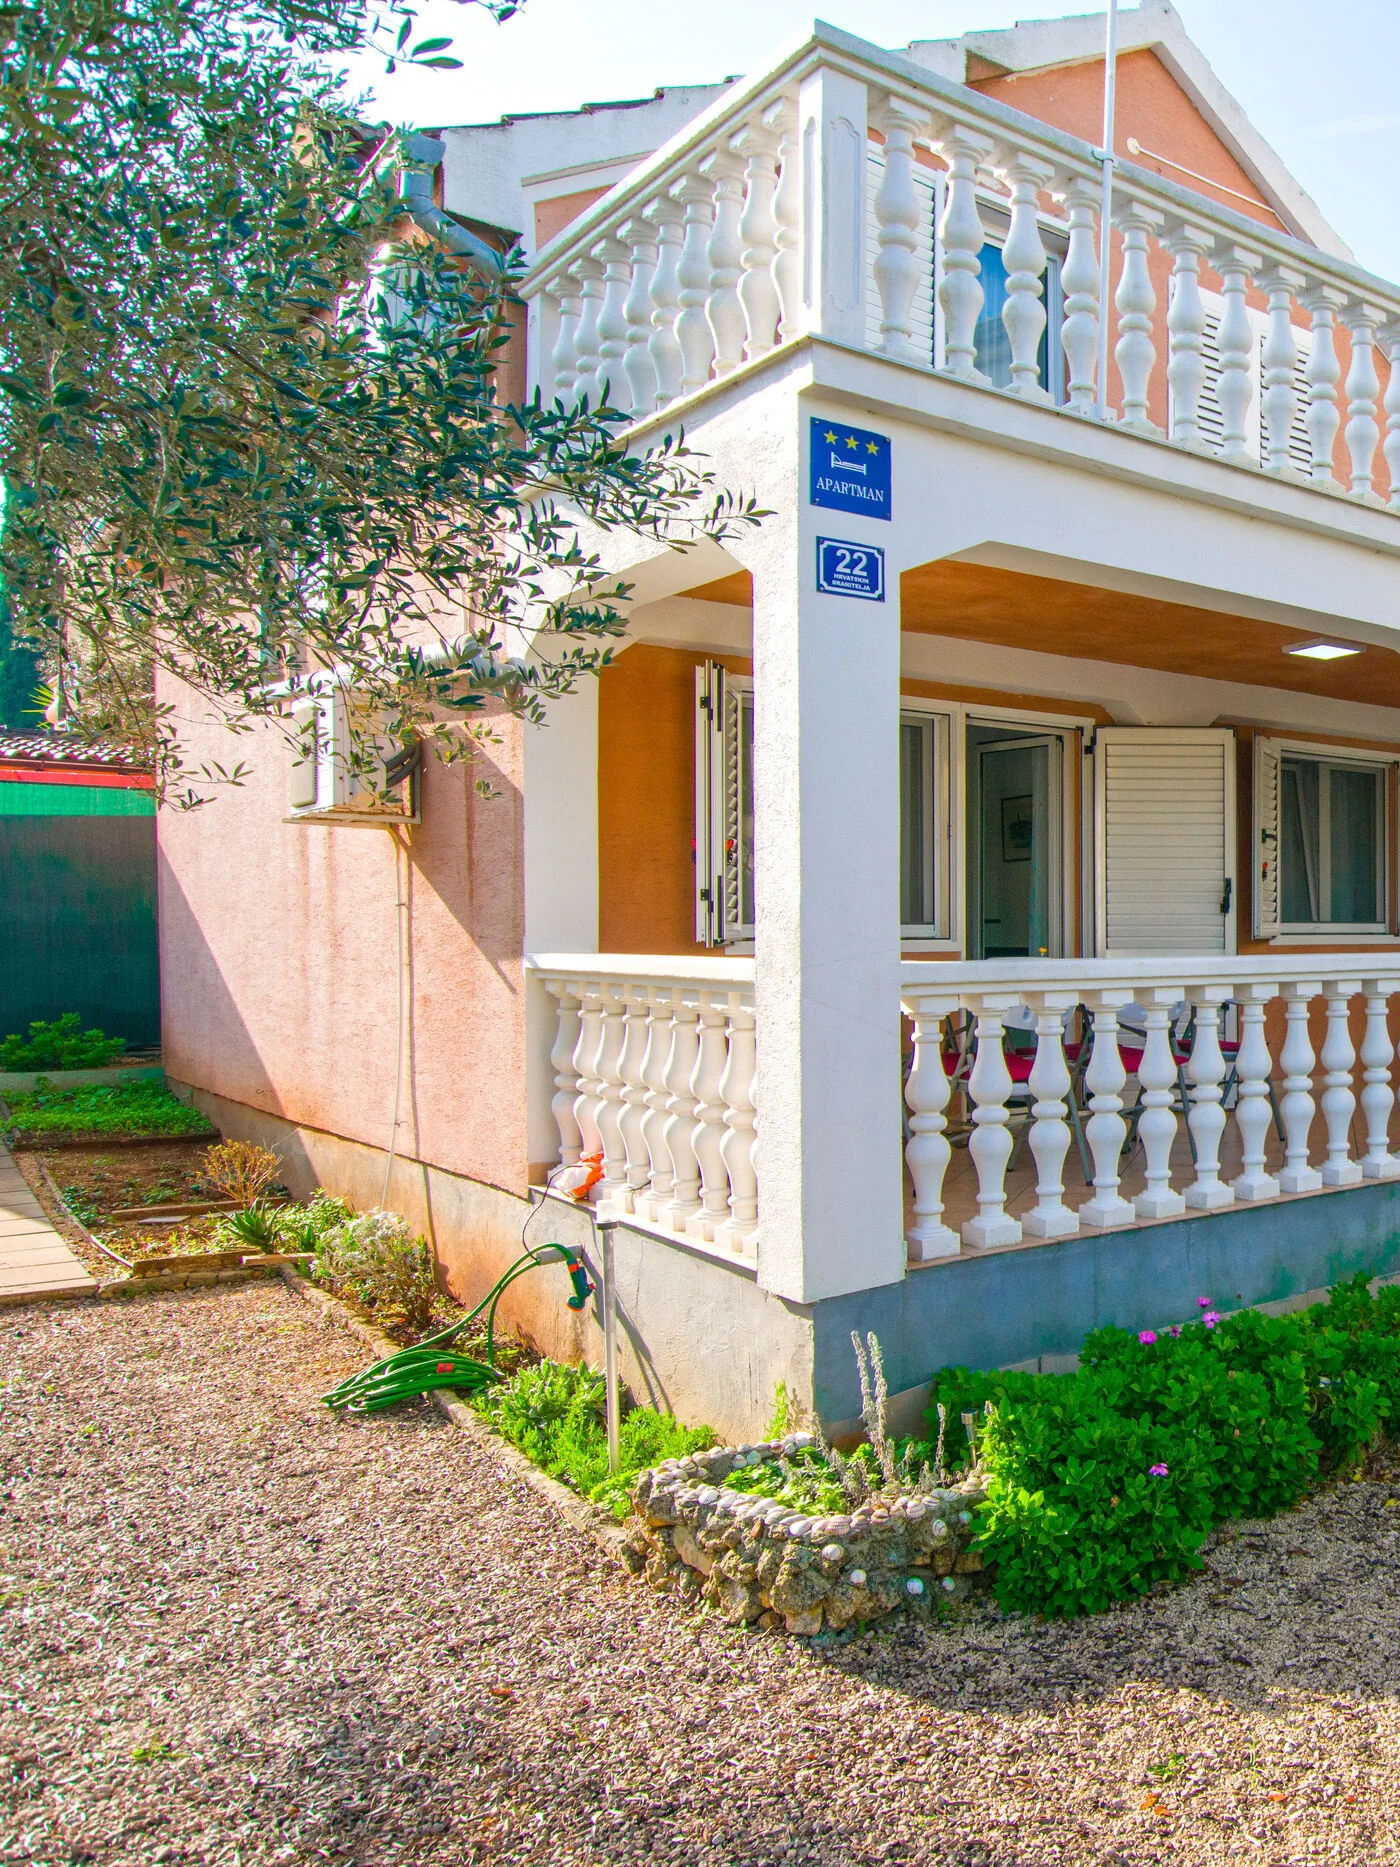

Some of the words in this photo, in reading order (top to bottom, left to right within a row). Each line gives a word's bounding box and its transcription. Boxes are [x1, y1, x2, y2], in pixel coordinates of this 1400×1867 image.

[816, 476, 884, 502] APARTMAN
[836, 548, 868, 577] 22
[832, 579, 870, 591] BRANITELJA
[833, 573, 869, 584] HRVATSKIH
